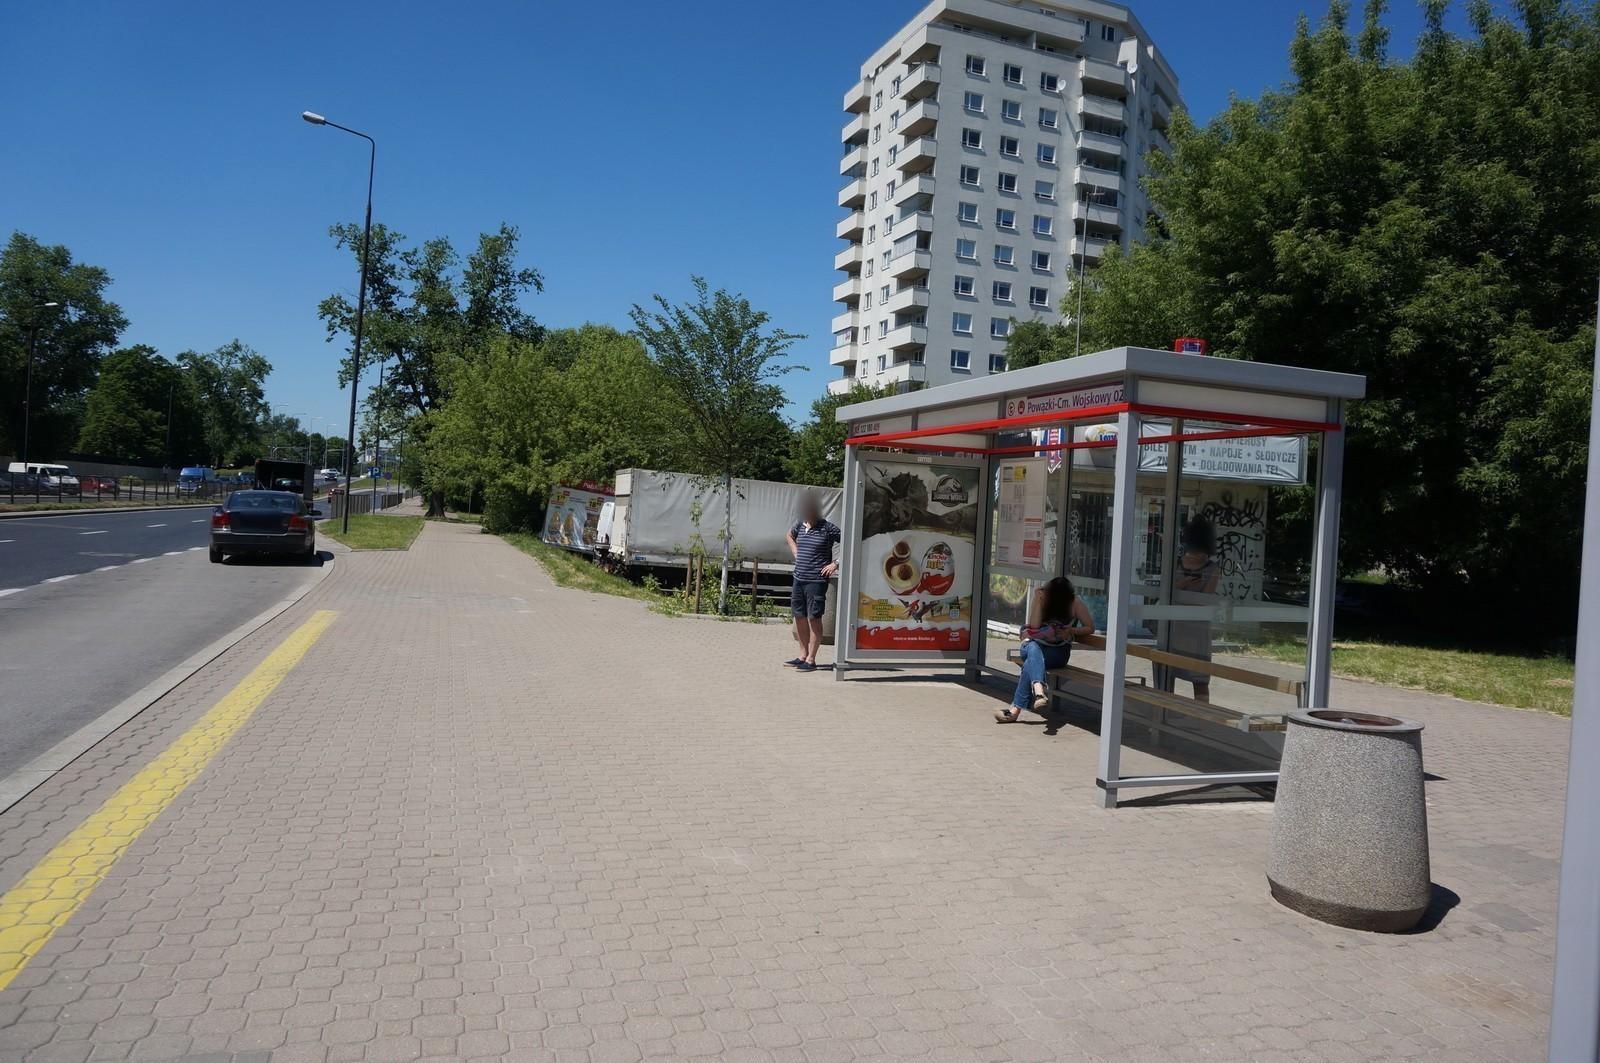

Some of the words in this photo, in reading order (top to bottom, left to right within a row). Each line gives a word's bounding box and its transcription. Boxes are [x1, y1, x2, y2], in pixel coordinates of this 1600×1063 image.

[1027, 397, 1071, 414] Powązki-Cm.
[1072, 393, 1111, 408] Wojskowy
[1113, 389, 1124, 401] 02
[1184, 445, 1197, 455] TM
[1210, 447, 1243, 459] NAPOJE
[1255, 450, 1297, 463] SŁODYCZE
[1200, 459, 1263, 475] DOŁADOWANIA
